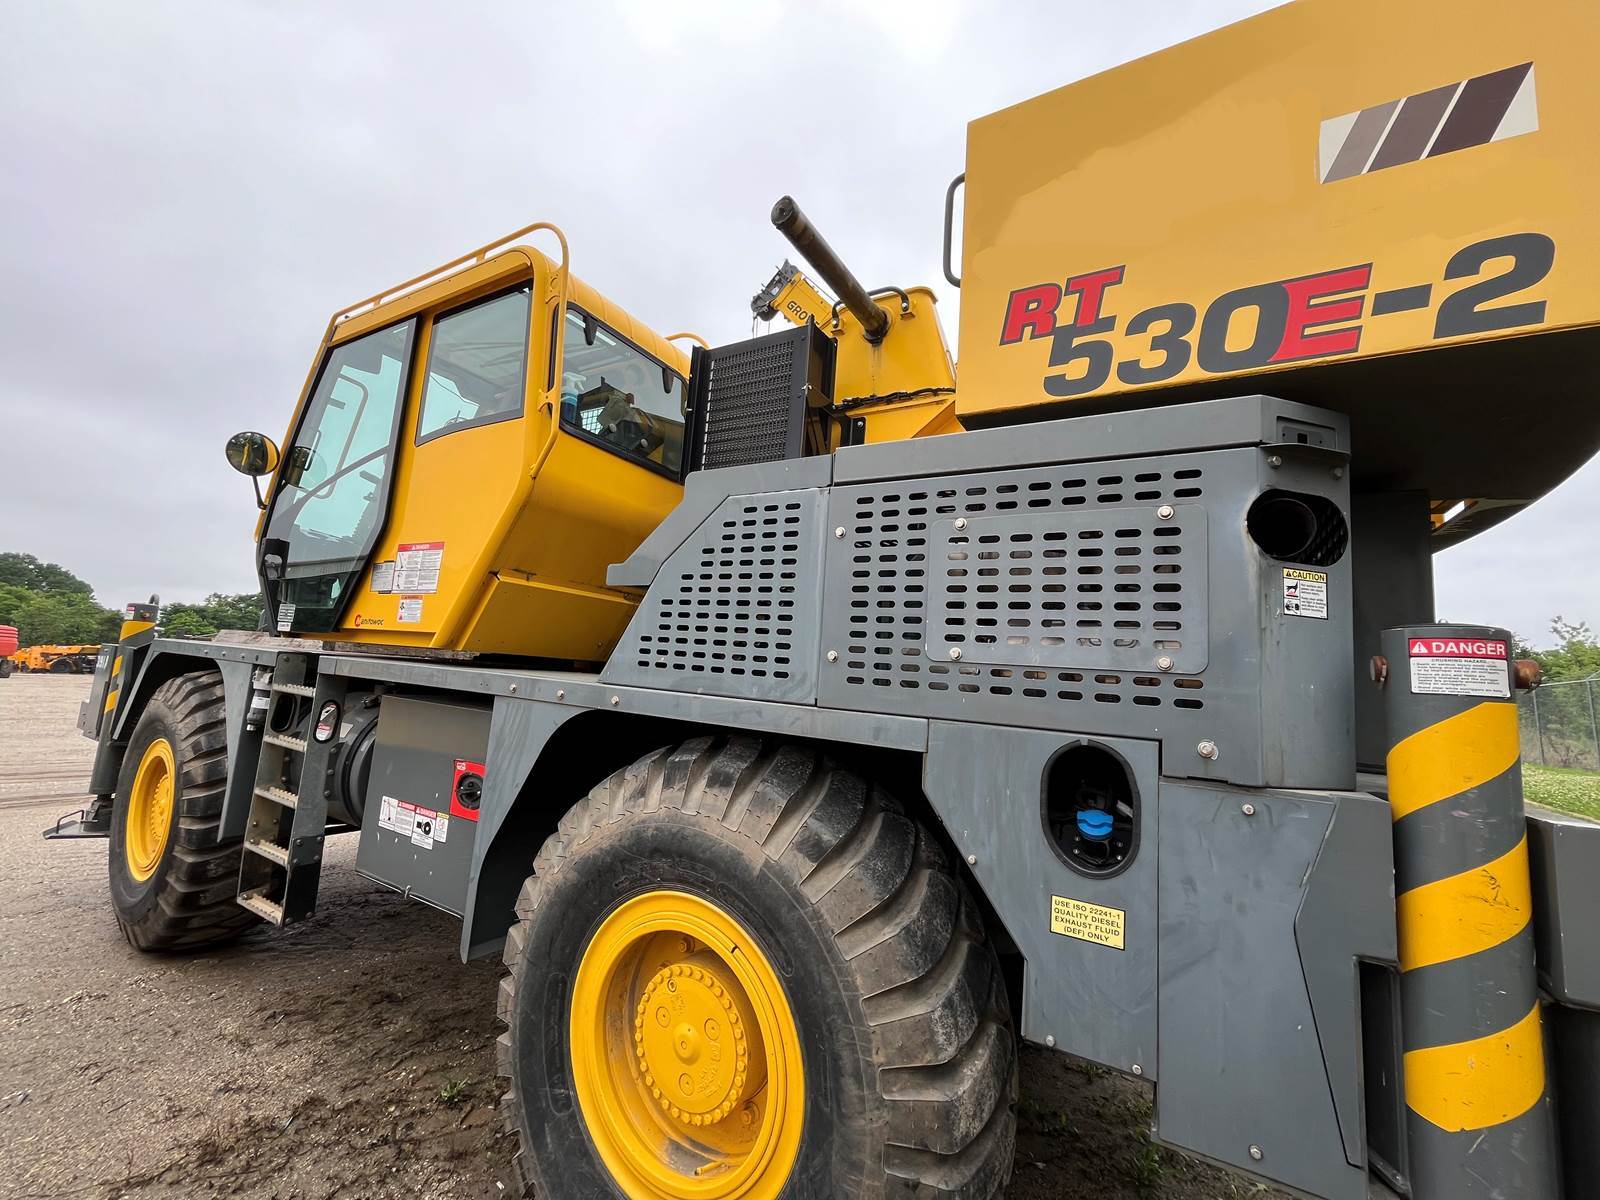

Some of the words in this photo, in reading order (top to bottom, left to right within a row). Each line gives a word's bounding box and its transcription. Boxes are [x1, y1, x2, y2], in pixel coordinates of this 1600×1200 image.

[787, 300, 820, 325] GRO
[999, 264, 1126, 345] RT
[1043, 232, 1556, 397] 530E-2
[1292, 570, 1325, 582] CAUTION
[1431, 641, 1506, 656] DANGER
[1054, 899, 1071, 908] USE
[1073, 903, 1087, 912] ISO
[1089, 907, 1120, 920] 22241-1
[1054, 907, 1089, 920] QUALITY
[1091, 916, 1121, 928] DIESEL
[1054, 915, 1092, 930] EXHAUST
[1095, 925, 1120, 936] FLUID
[1064, 926, 1085, 937] (DEF)
[1087, 931, 1110, 942] ONLY
